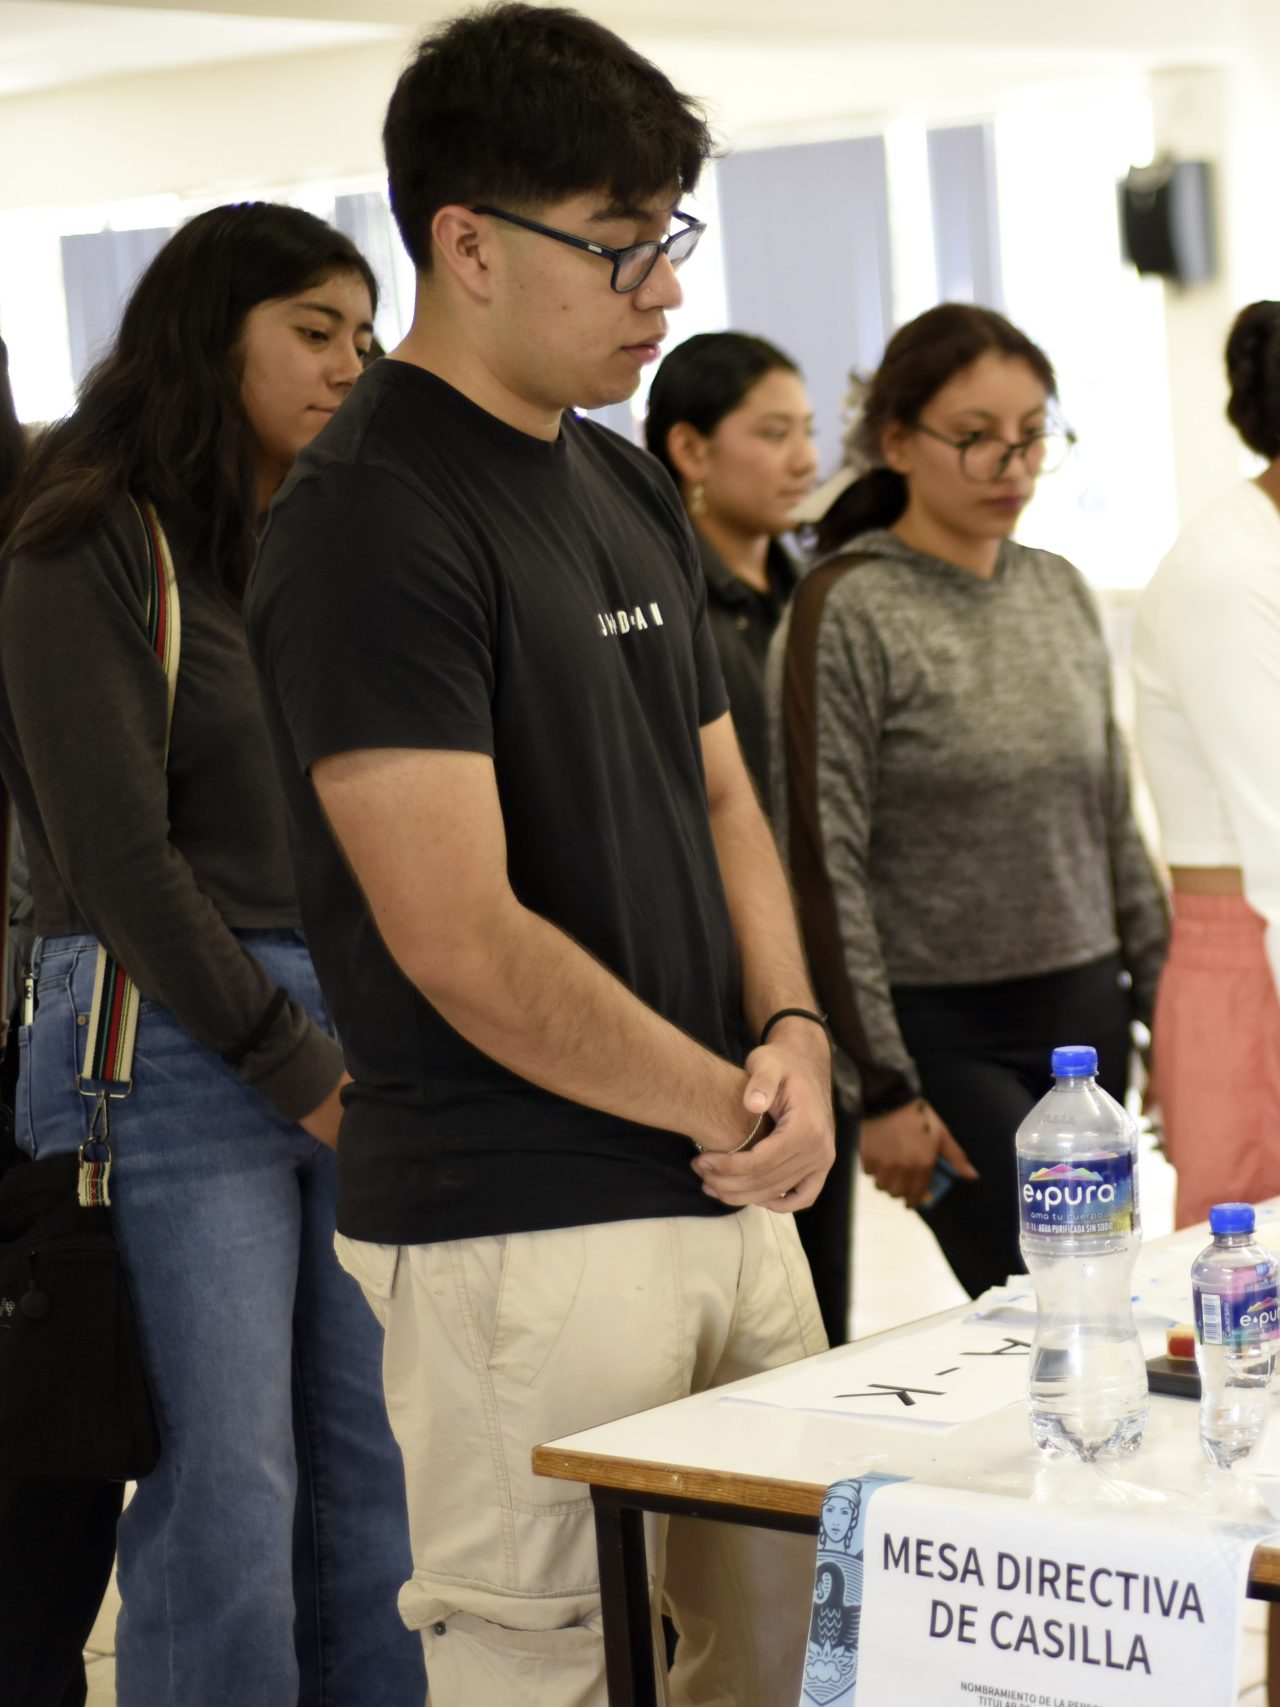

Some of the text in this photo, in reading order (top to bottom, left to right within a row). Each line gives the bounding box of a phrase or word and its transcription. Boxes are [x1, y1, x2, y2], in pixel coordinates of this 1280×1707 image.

[1030, 1212, 1049, 1220] ama
[1052, 1213, 1063, 1221] tu
[1038, 1223, 1052, 1233] AGUA
[1051, 1224, 1085, 1234] PURIFICADA
[1085, 1223, 1097, 1233] SIN
[882, 1532, 1206, 1624] MESA DIRECTIVA
[928, 1598, 1153, 1676] DE CASILLA
[960, 1681, 1037, 1704] NOMBRAMIENTO
[1038, 1694, 1051, 1707] DE
[1053, 1696, 1066, 1707] LA
